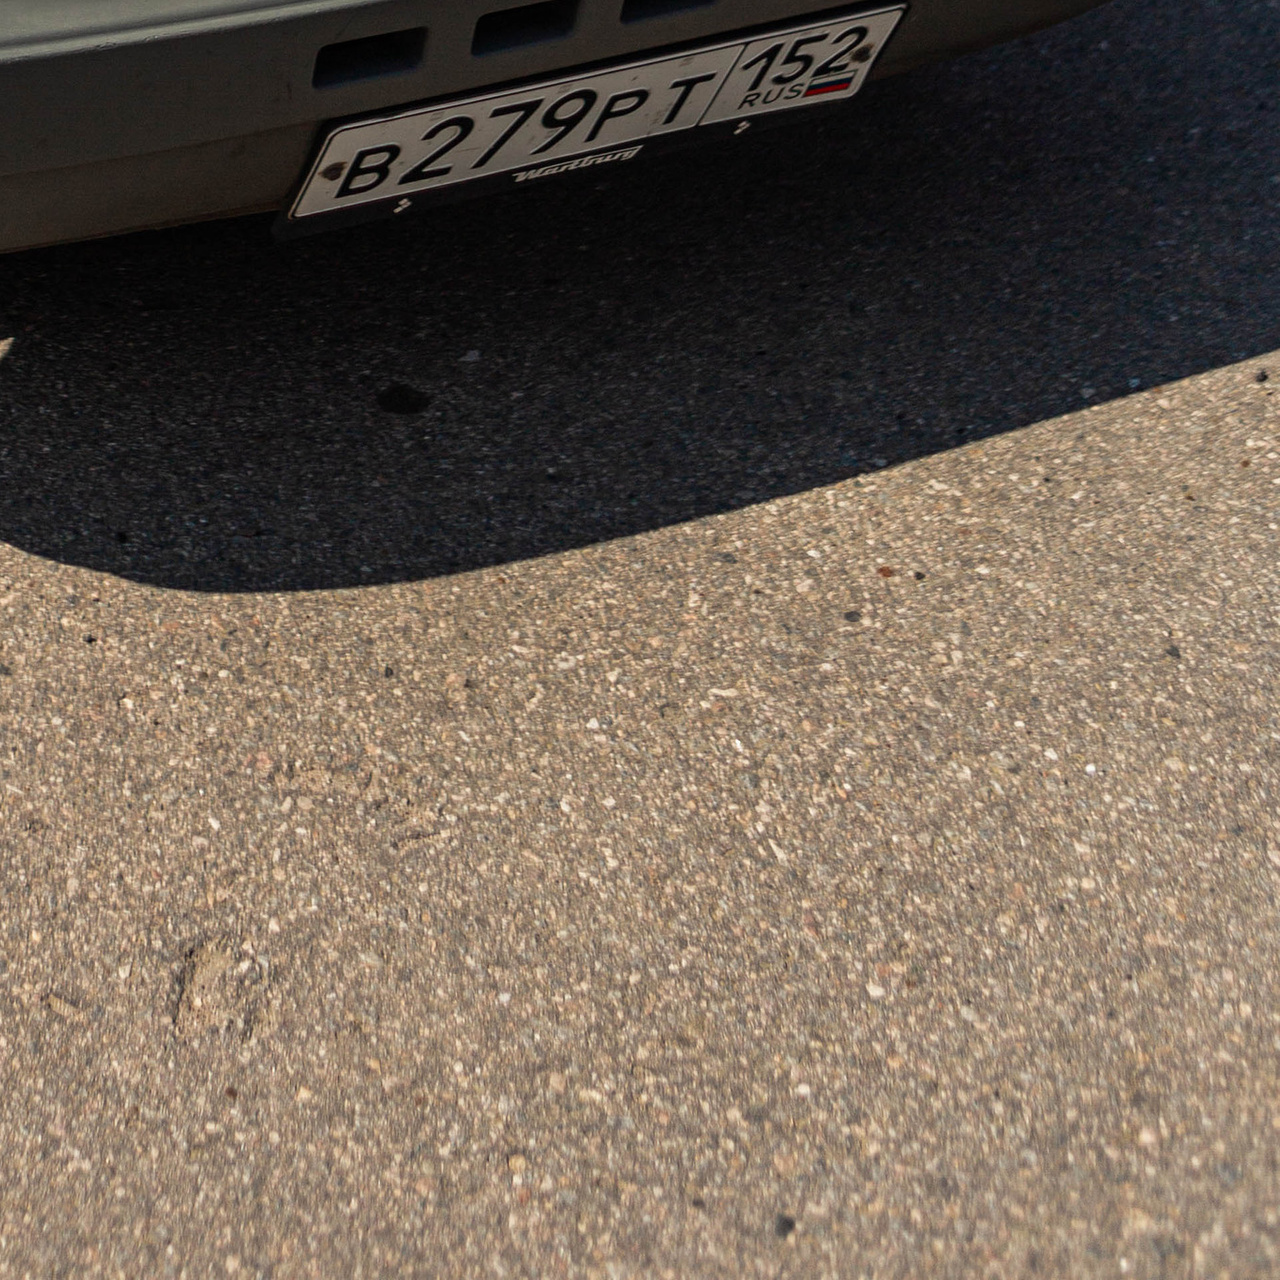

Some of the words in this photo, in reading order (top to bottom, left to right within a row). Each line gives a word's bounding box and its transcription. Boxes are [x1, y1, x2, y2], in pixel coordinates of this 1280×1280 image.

[740, 24, 870, 92] 152
[738, 81, 806, 112] RUS
[511, 144, 645, 183] Wartburg
